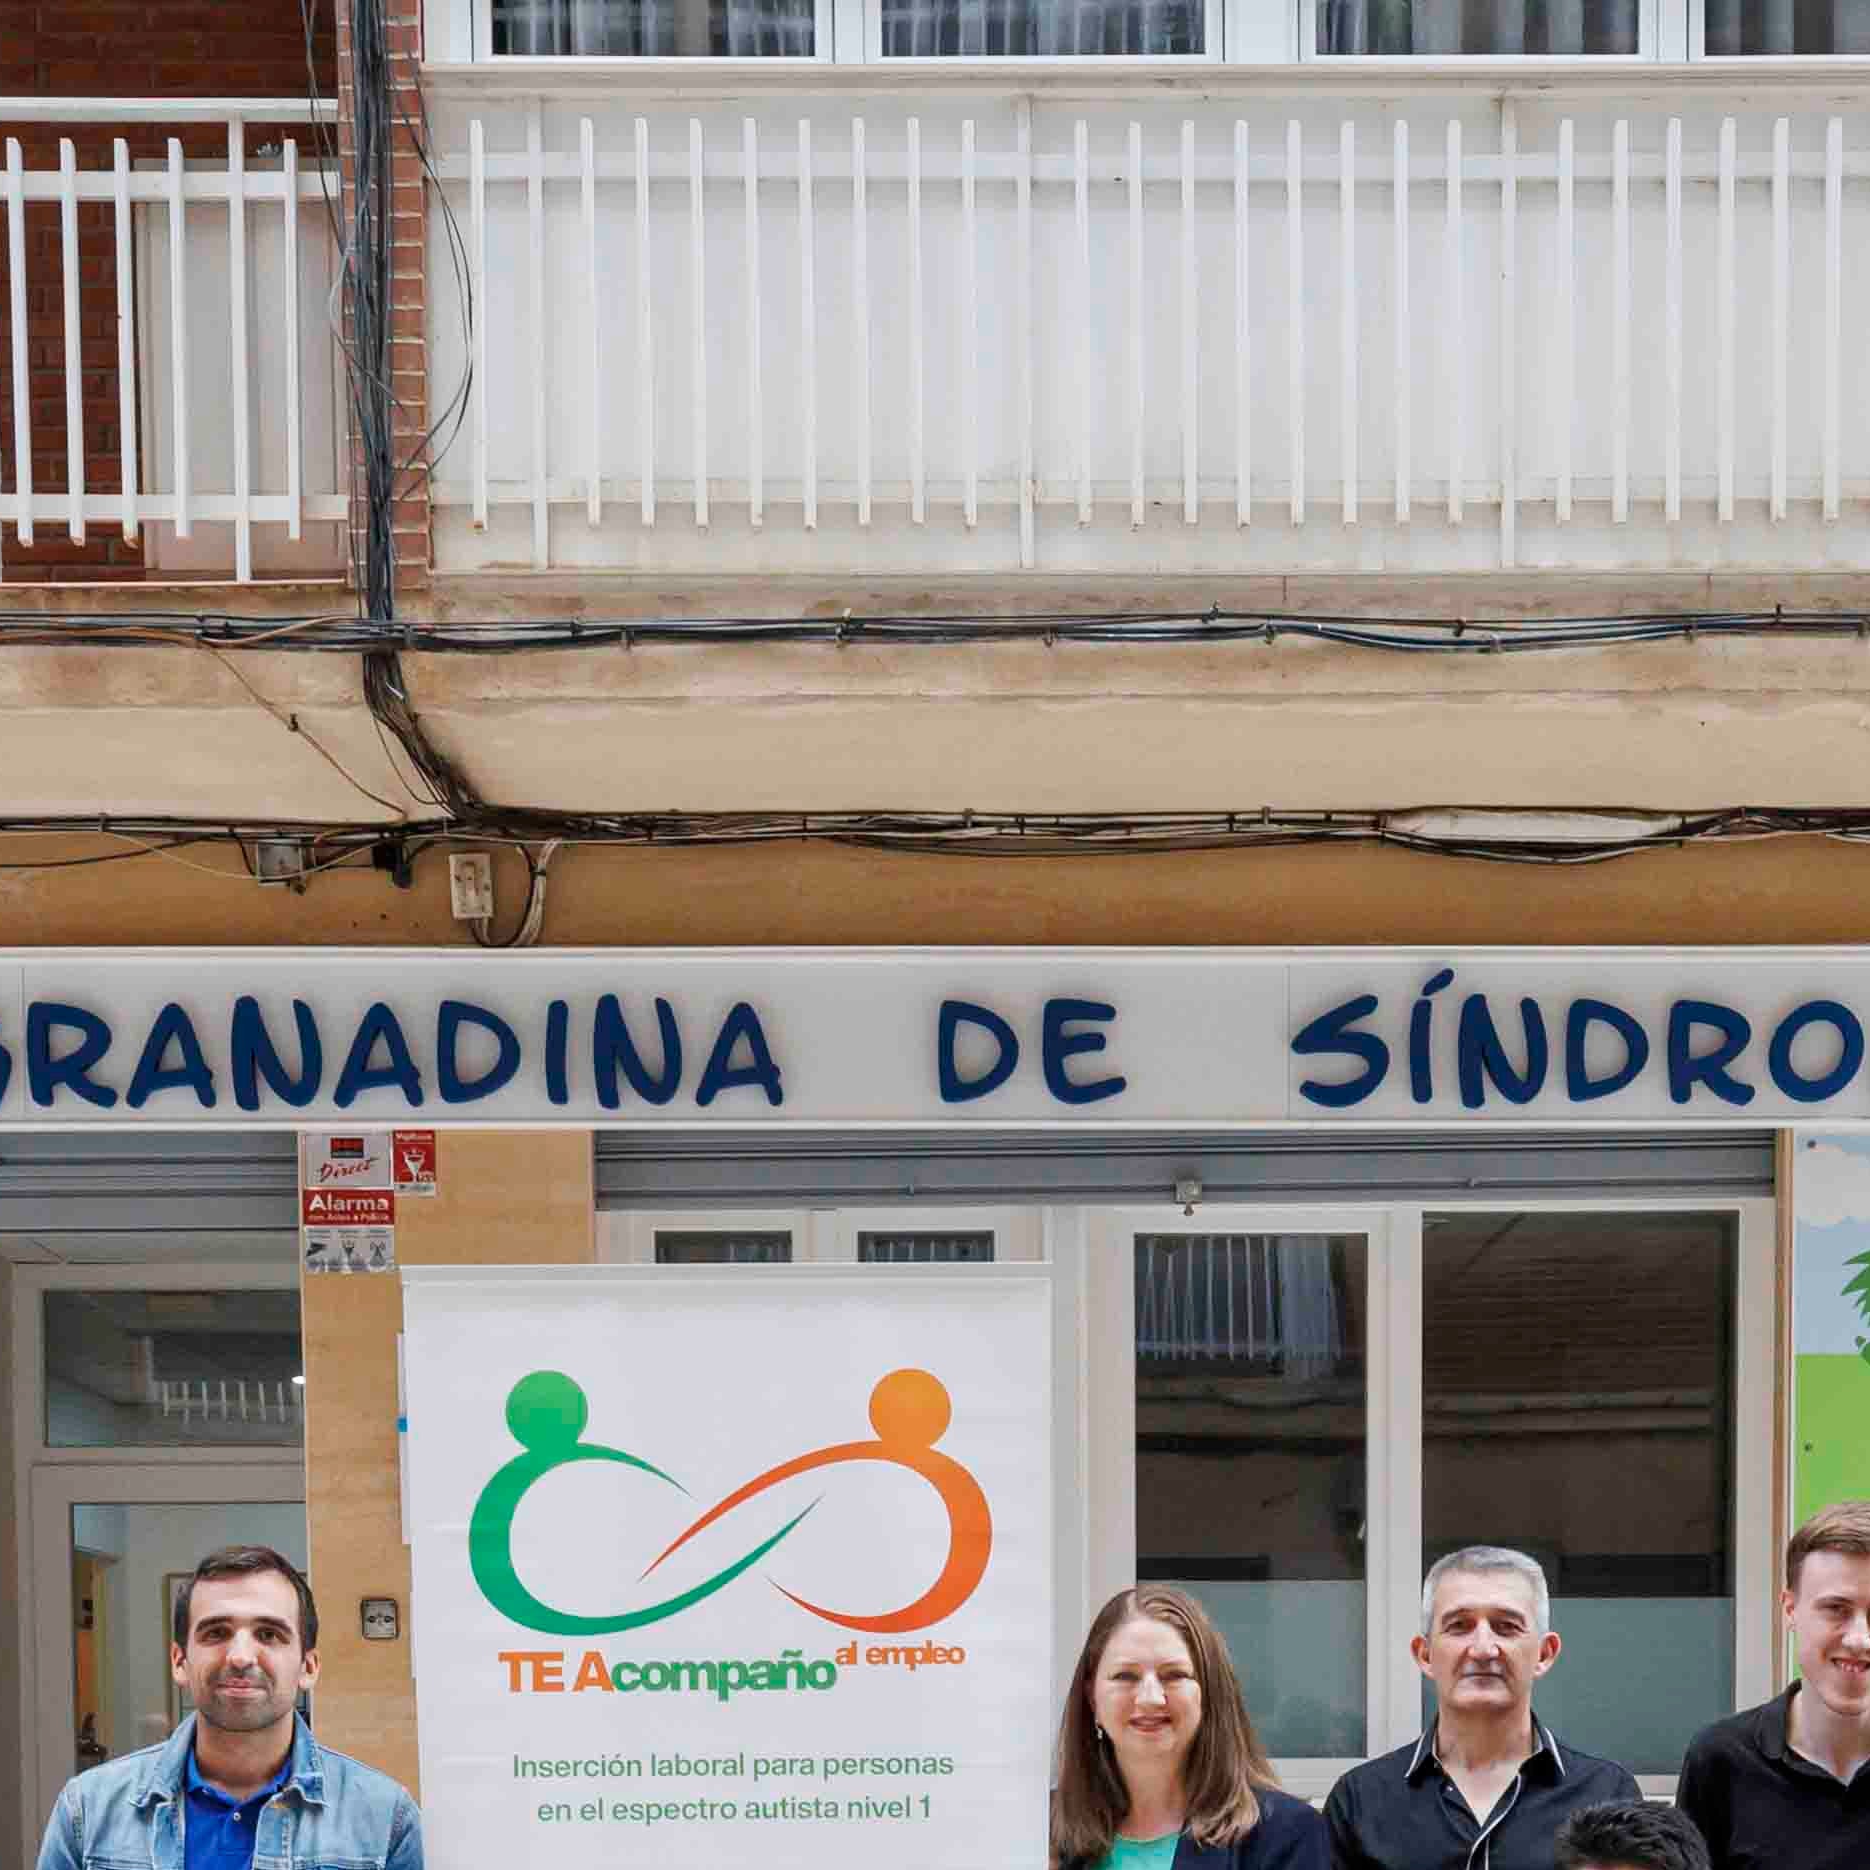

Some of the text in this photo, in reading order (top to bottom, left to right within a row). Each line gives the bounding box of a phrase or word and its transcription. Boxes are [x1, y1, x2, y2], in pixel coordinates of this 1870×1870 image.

[939, 998, 1127, 1104] DE
[309, 1193, 390, 1212] Alarma
[572, 1648, 836, 1702] Acompaño
[835, 1641, 858, 1665] al
[866, 1641, 966, 1671] empleo
[513, 1752, 954, 1782] Inserción laboral para personas
[537, 1794, 931, 1827] en el espectro autista nivel 1
